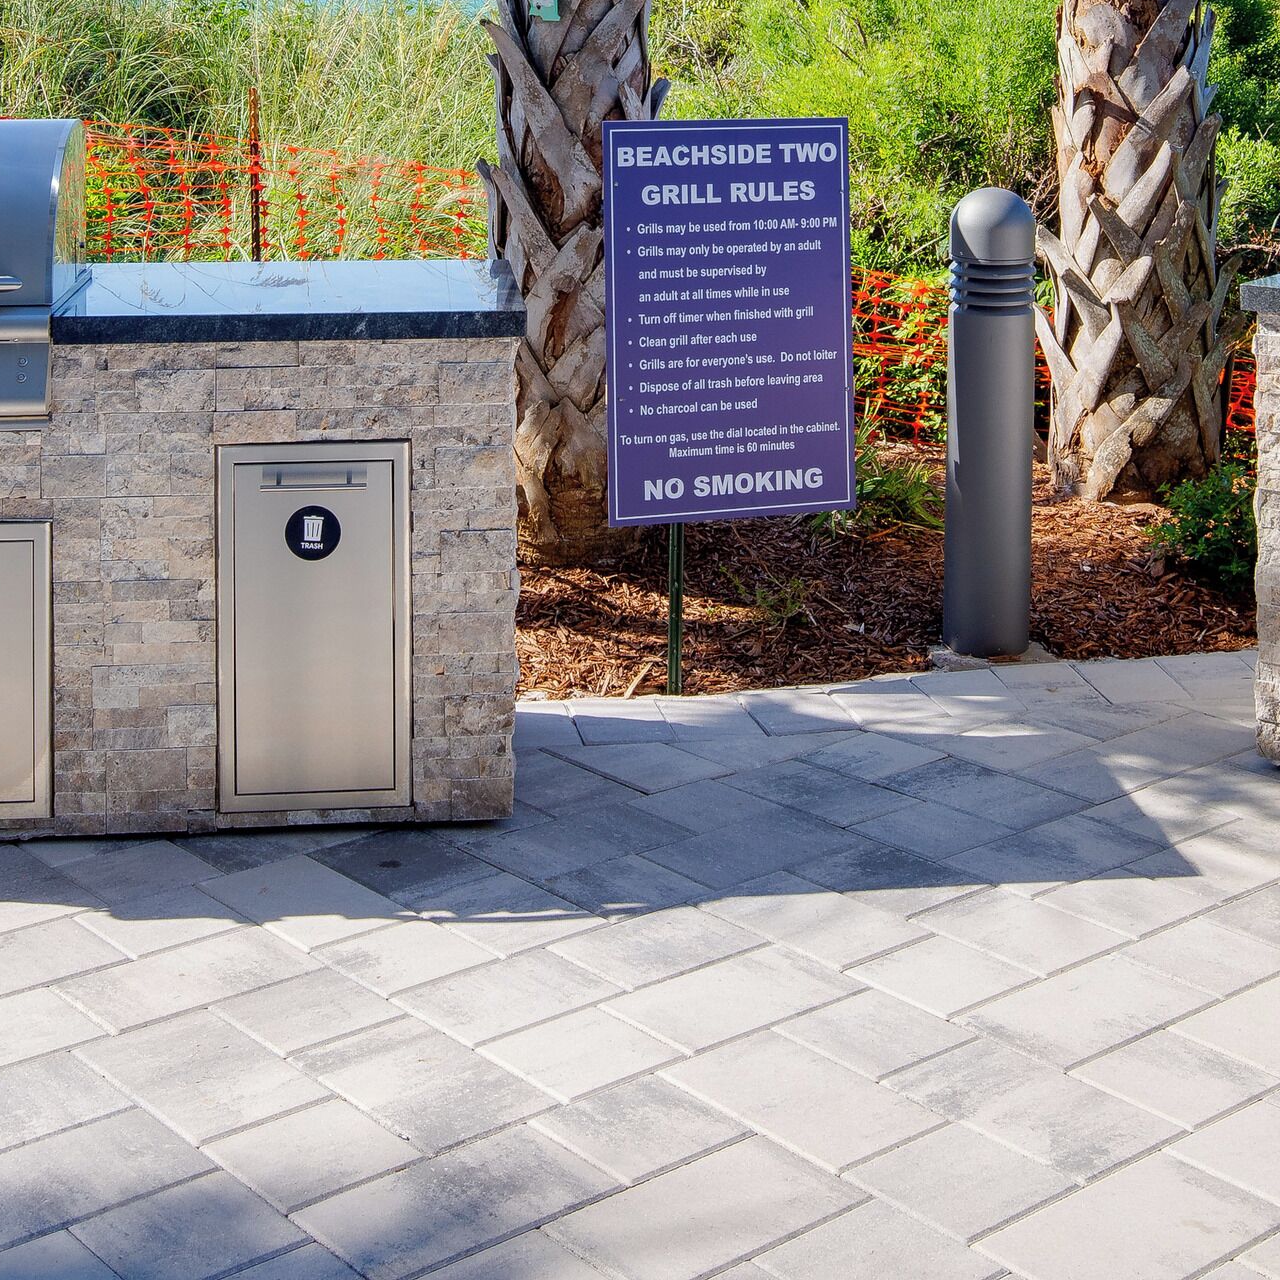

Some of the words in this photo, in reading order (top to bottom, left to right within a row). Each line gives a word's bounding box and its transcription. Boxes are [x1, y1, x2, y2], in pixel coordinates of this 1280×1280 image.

[617, 143, 772, 167] BEACHSIDE
[778, 142, 837, 163] TWO
[641, 183, 722, 206] GRILL
[730, 180, 816, 203] RULES
[636, 222, 664, 234] Grills
[665, 224, 686, 236] may
[688, 221, 701, 233] be
[702, 220, 726, 232] used
[728, 219, 751, 231] from
[752, 218, 778, 230] 10:00
[800, 217, 821, 229] 9:00
[822, 216, 837, 228] PM
[637, 245, 664, 257] Grills
[665, 246, 687, 258] may
[688, 243, 710, 257] only
[711, 243, 724, 254] be
[725, 241, 768, 256] operated
[769, 240, 782, 255] by
[783, 242, 796, 251] an
[797, 239, 822, 251] adult
[638, 268, 657, 280] and
[659, 267, 684, 279] must
[686, 266, 699, 278] be
[700, 264, 753, 279] supervised
[754, 263, 767, 277] by
[638, 293, 651, 303] an
[653, 289, 679, 302] adult
[679, 289, 690, 301] at
[691, 288, 704, 300] all
[705, 287, 732, 299] times
[733, 286, 759, 298] while
[761, 285, 770, 297] in
[772, 286, 790, 296] use
[638, 313, 661, 325] Turn
[662, 312, 677, 324] off
[678, 311, 704, 323] timer
[705, 310, 732, 322] when
[733, 307, 772, 320] finished
[773, 306, 794, 318] with
[795, 305, 814, 320] grill
[638, 336, 667, 348] Clean
[668, 334, 688, 349] grill
[690, 333, 713, 345] after
[714, 331, 738, 344] each
[739, 332, 757, 342] use
[639, 358, 666, 370] Grills
[667, 359, 684, 369] are
[685, 356, 700, 368] for
[701, 353, 754, 369] everyone's
[755, 354, 776, 364] use.
[780, 351, 794, 362] Do
[795, 350, 812, 361] not
[813, 348, 838, 361] loiter
[639, 381, 680, 395] Dispose
[681, 378, 692, 391] of
[693, 378, 706, 390] all
[707, 377, 732, 389] trash
[734, 375, 765, 387] before
[766, 373, 801, 386] leaving
[802, 373, 823, 383] area
[639, 404, 654, 416] No
[656, 401, 698, 415] charcoal
[700, 402, 718, 412] can
[720, 399, 733, 411] be
[734, 397, 758, 410] used
[619, 434, 632, 446] To
[633, 434, 653, 445] turn
[654, 434, 667, 443] on
[669, 433, 689, 445] gas,
[690, 431, 708, 441] use
[709, 428, 724, 440] the
[726, 426, 743, 439] dial
[744, 424, 777, 437] located
[778, 424, 788, 435] in
[789, 423, 804, 434] the
[805, 421, 841, 433] cabinet.
[668, 446, 713, 458] Maximum
[714, 444, 735, 455] time
[736, 442, 745, 453] is
[746, 441, 758, 453] 60
[759, 440, 795, 452] minutes
[643, 477, 685, 501] NO
[693, 467, 823, 497] SMOKING
[300, 542, 324, 551] TRASH
